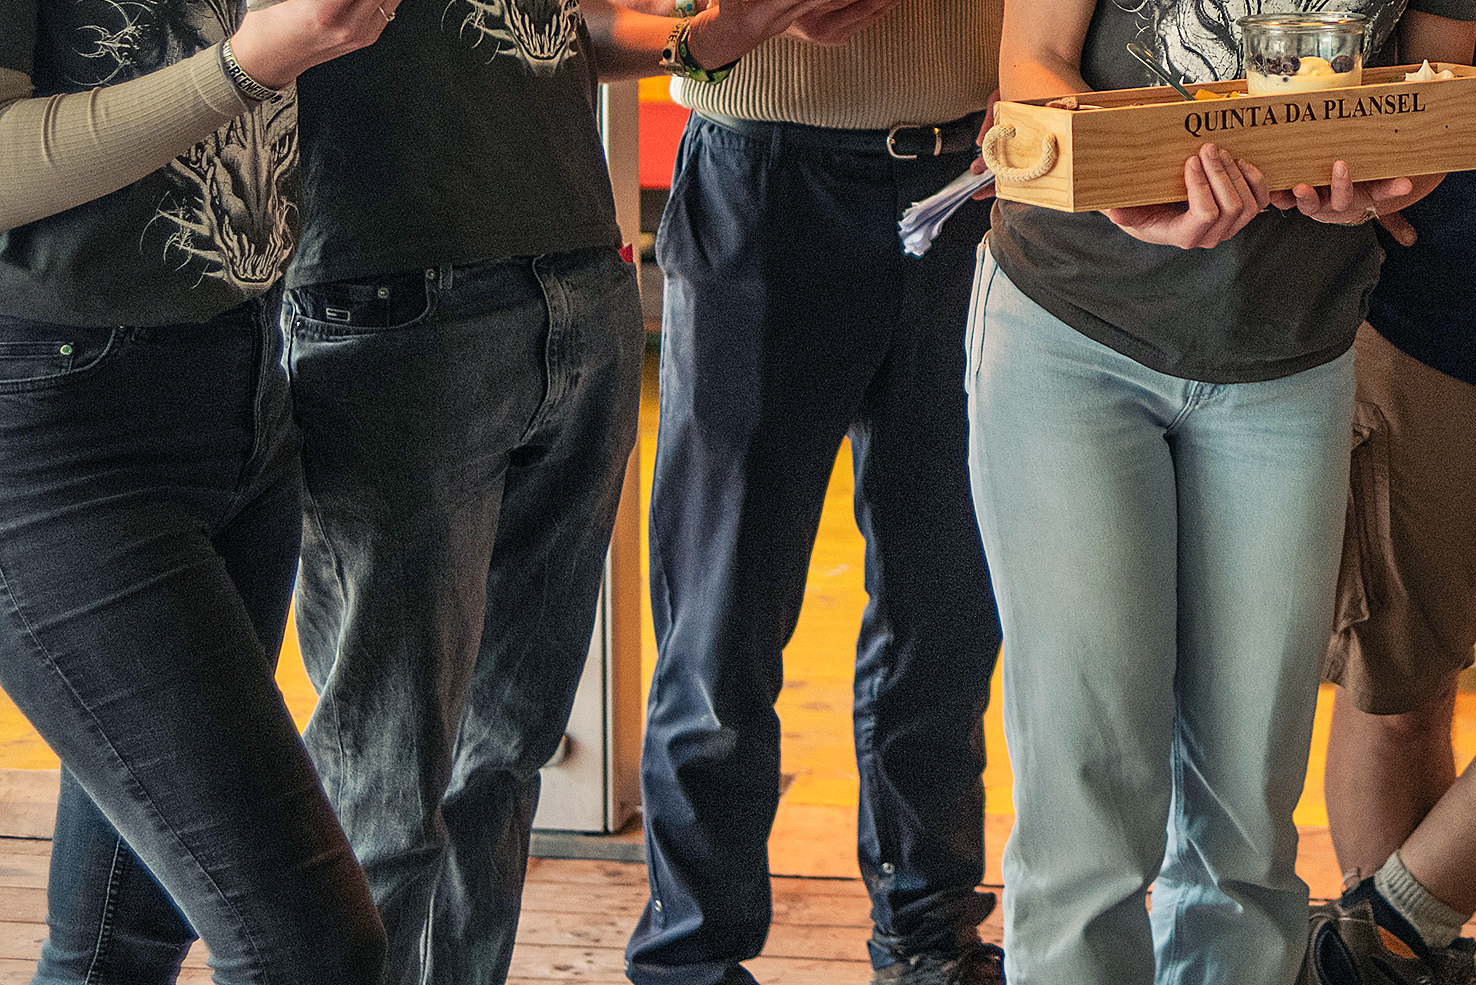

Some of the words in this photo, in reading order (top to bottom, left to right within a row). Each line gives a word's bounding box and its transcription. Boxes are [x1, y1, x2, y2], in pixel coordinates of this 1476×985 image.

[1184, 105, 1278, 137] QUINTA
[1285, 102, 1317, 123] DA
[1323, 93, 1426, 119] PLANSEL
